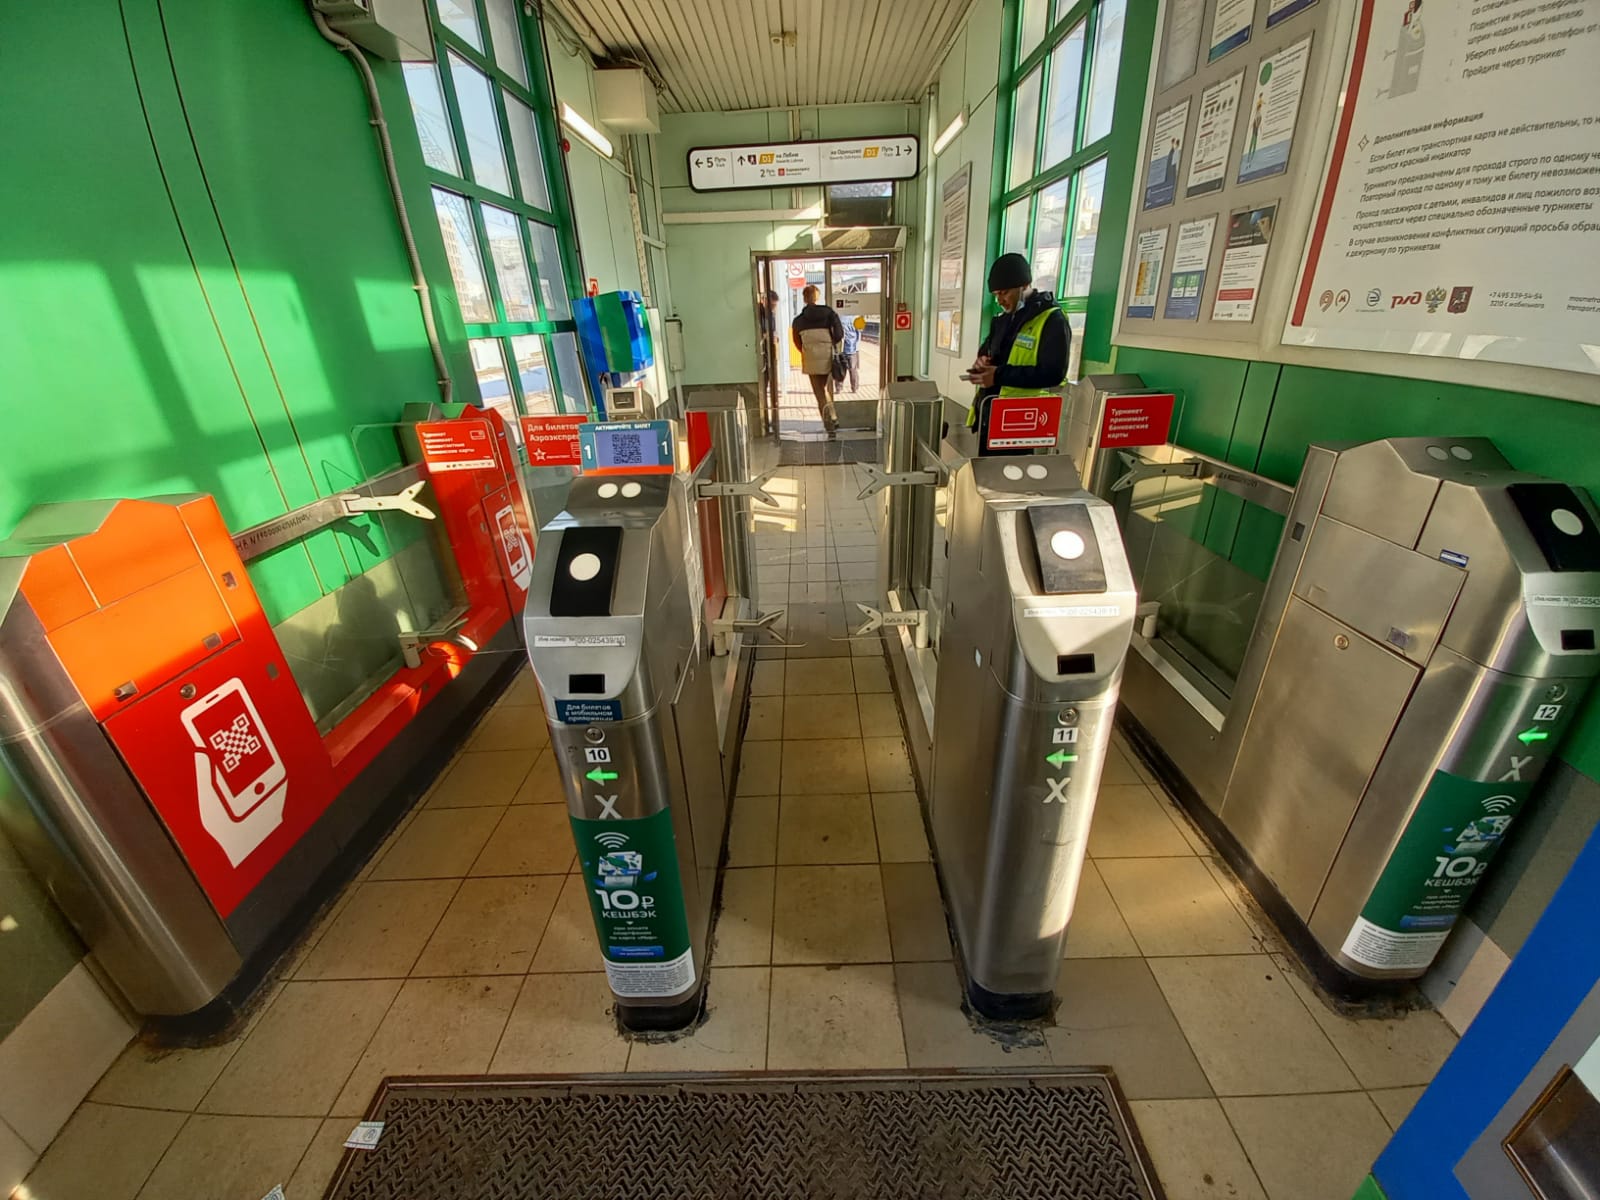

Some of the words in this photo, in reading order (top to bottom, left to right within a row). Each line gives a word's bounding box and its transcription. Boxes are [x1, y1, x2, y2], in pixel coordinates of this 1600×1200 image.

[1465, 47, 1496, 62] Уберите
[1498, 33, 1545, 53] мобильный
[1548, 26, 1584, 40] телефон
[1462, 63, 1500, 79] Пройдите
[1501, 56, 1526, 70] через
[1527, 48, 1566, 65] турникет
[1373, 124, 1432, 146] Дополнительная
[1432, 112, 1484, 129] информация
[1369, 154, 1386, 163] Если
[1386, 148, 1406, 160] билет
[1421, 134, 1472, 151] транспортная
[1474, 130, 1496, 143] карта
[1498, 128, 1508, 137] не
[1582, 117, 1592, 125] то
[896, 145, 900, 156] 1
[1400, 154, 1430, 168] красный
[1430, 148, 1472, 161] индикатор
[706, 157, 714, 168] 5
[760, 168, 766, 178] 2
[1363, 179, 1397, 192] Турникеты
[1398, 170, 1455, 184] предназначены
[1455, 165, 1470, 176] для
[1472, 160, 1506, 173] прохода
[1508, 157, 1538, 168] строго
[1540, 156, 1552, 164] по
[1553, 152, 1590, 164] одному
[1360, 188, 1396, 202] Повторный
[1397, 186, 1423, 197] проход
[1424, 183, 1434, 192] по
[1434, 180, 1464, 192] одному
[1472, 176, 1493, 186] тому
[1494, 174, 1506, 182] же
[1508, 170, 1540, 181] билету
[1356, 210, 1380, 220] Проход
[1380, 204, 1422, 216] пассажиров
[1461, 193, 1506, 204] инвалидов
[1508, 192, 1514, 200] и
[1515, 192, 1533, 200] лиц
[1534, 188, 1582, 198] пожилого
[1583, 187, 1600, 196] воз
[1405, 214, 1427, 224] через
[1428, 210, 1475, 221] специально
[1476, 204, 1540, 216] обозначенные
[1542, 202, 1594, 214] турникеты
[1348, 238, 1354, 246] В
[1354, 238, 1376, 247] случае
[1377, 232, 1430, 243] возникновения
[1431, 227, 1485, 238] конфликтных
[1486, 223, 1528, 236] ситуаций
[1530, 221, 1570, 234] просьба
[1388, 246, 1397, 254] по
[1398, 244, 1440, 255] турникетам
[1110, 416, 1149, 424] принимает
[1112, 408, 1144, 416] Турникет
[528, 423, 544, 432] Для
[546, 423, 578, 431] билетов
[584, 444, 592, 460] 1
[662, 440, 668, 456] 1
[1540, 706, 1557, 718] 12
[1057, 730, 1073, 741] 11
[589, 748, 607, 761] 10
[602, 910, 657, 918] КЕШБЭК
